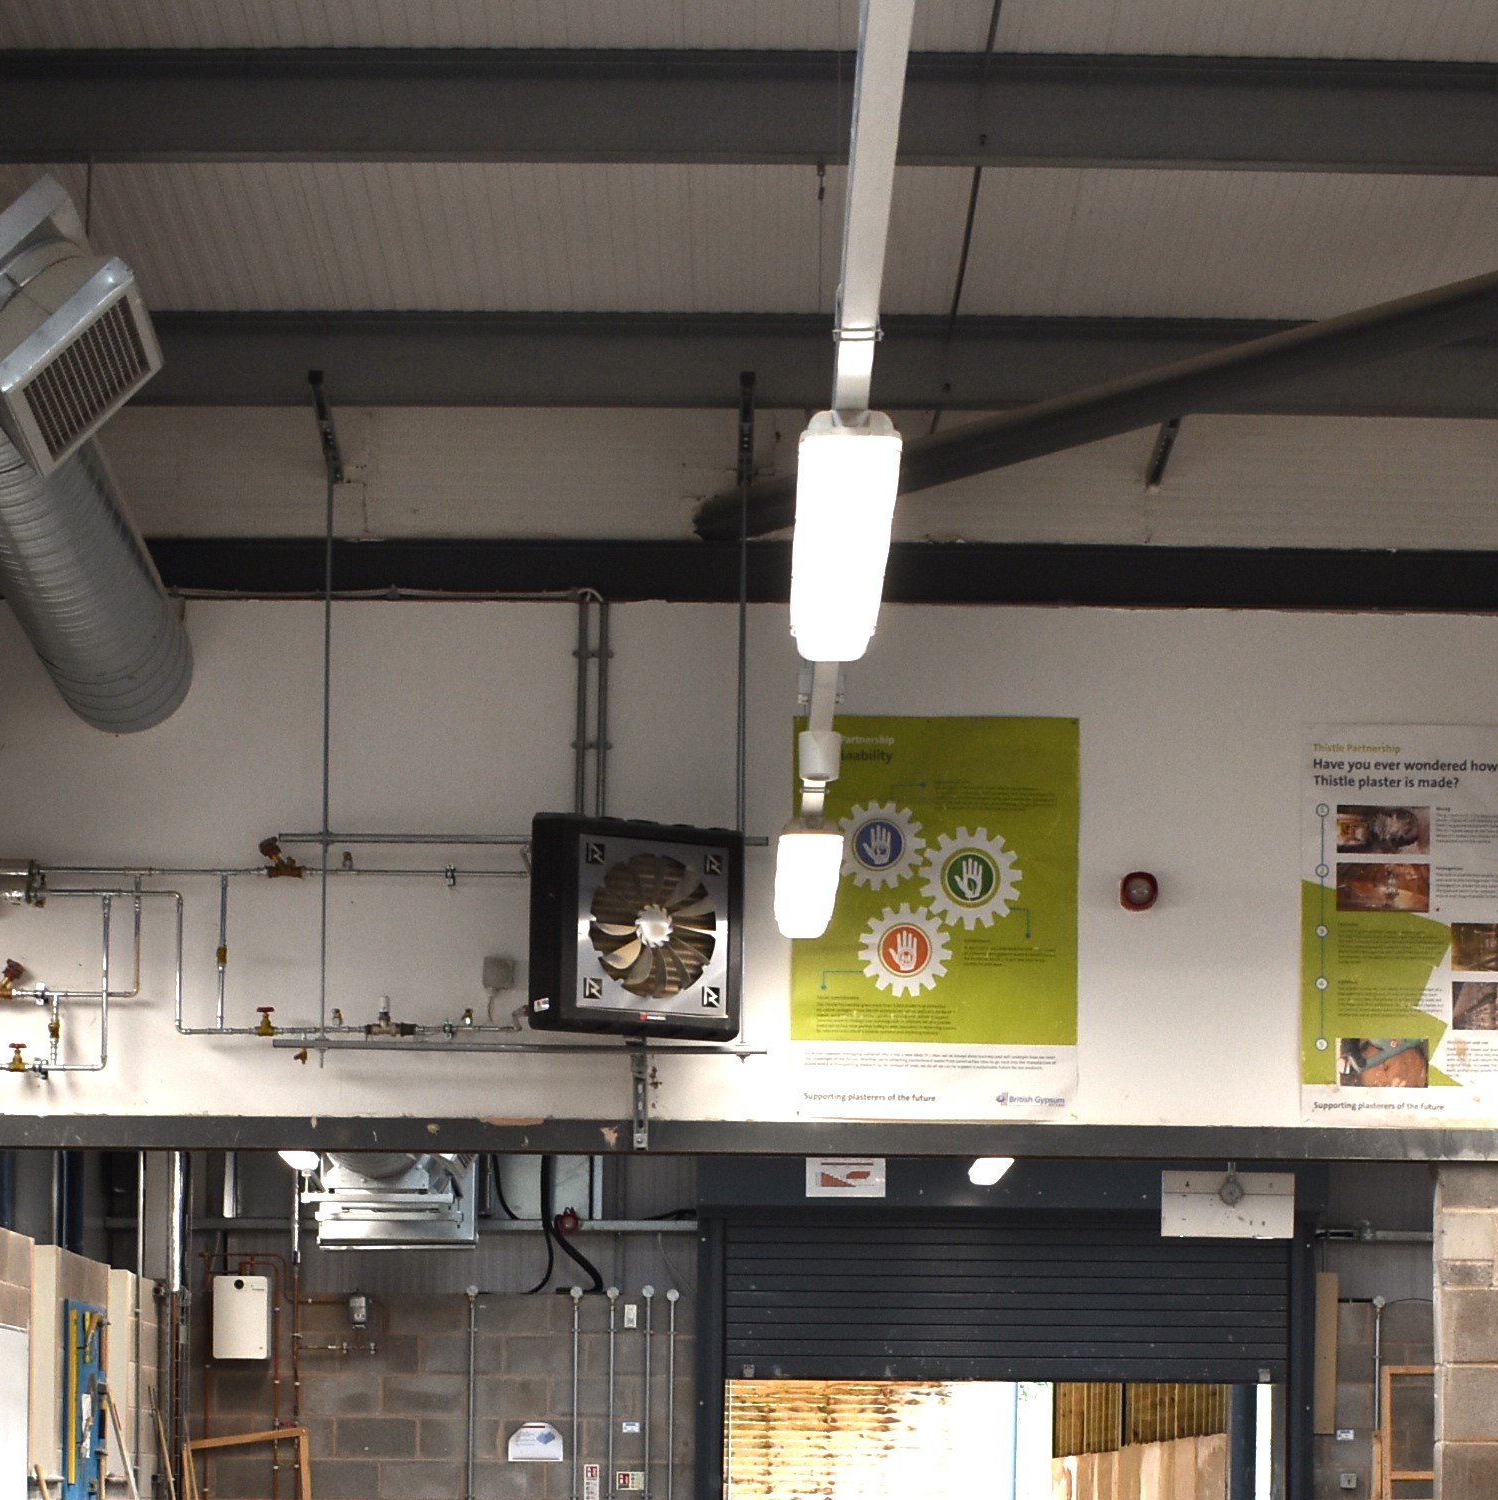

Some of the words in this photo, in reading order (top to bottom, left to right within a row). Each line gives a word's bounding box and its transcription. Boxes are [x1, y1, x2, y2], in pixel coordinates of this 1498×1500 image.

[841, 735, 895, 746] Partnership
[1313, 744, 1344, 752] Thistle
[1347, 744, 1401, 755] Partnership
[841, 749, 893, 763] inability
[1313, 758, 1345, 770] Have
[1347, 761, 1370, 773] you
[1374, 762, 1401, 770] ever
[1404, 760, 1466, 771] wondered
[1470, 760, 1498, 771] how
[1314, 775, 1355, 787] Thistle
[1358, 776, 1401, 789] plaster
[1405, 777, 1414, 787] is
[1418, 777, 1459, 788] made?
[804, 1092, 846, 1102] Supporting
[848, 1093, 885, 1102] plasterers
[912, 1094, 936, 1102] future
[1035, 1096, 1065, 1104] Gypsum
[1313, 1101, 1356, 1110] Supporting
[1358, 1102, 1395, 1110] plasterers
